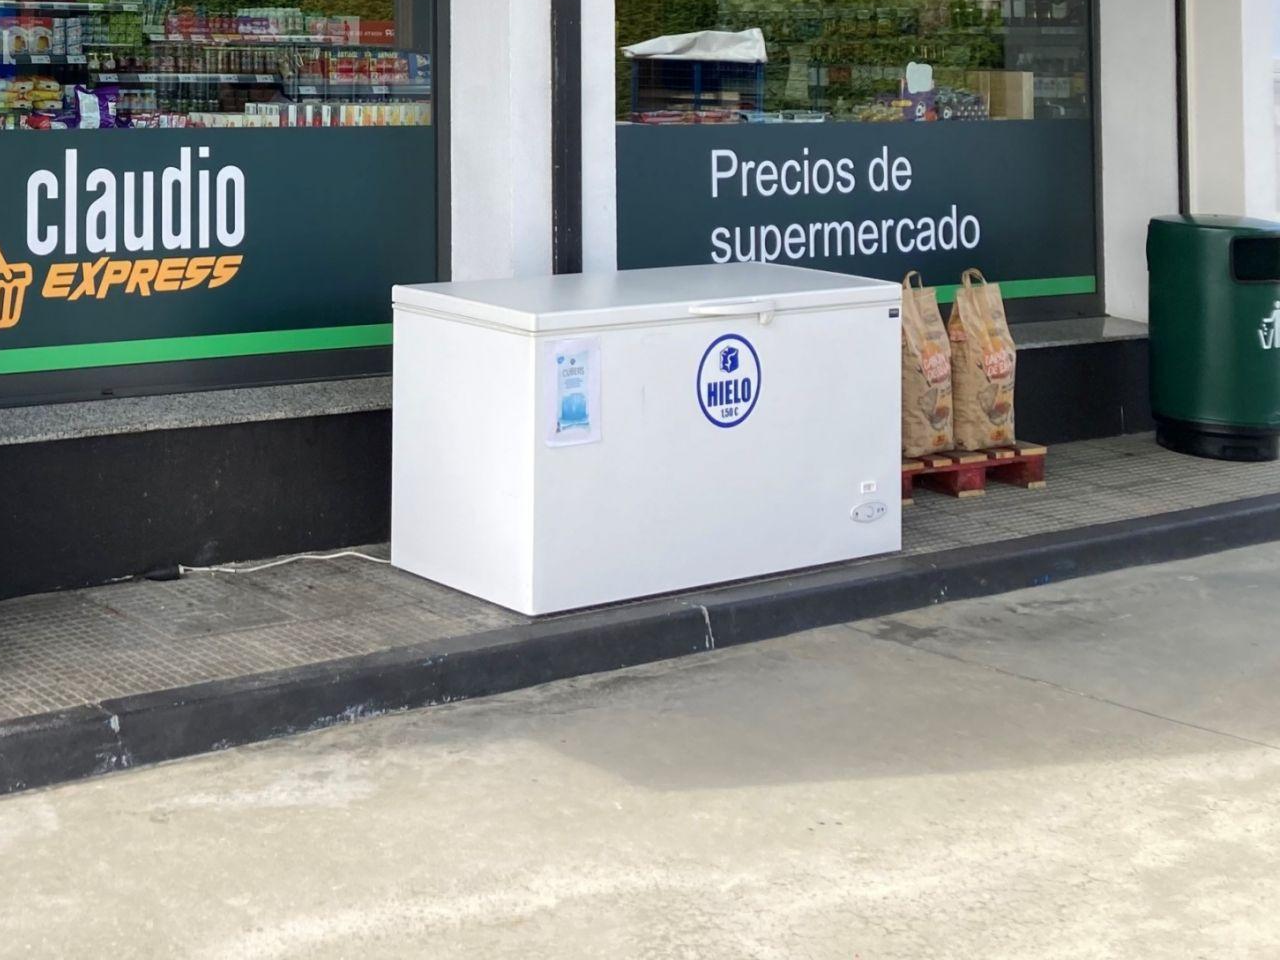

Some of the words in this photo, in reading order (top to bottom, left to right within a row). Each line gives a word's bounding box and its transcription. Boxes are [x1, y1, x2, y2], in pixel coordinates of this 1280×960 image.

[711, 147, 856, 198] Precios
[868, 145, 913, 192] de
[26, 146, 246, 256] claudio
[710, 204, 981, 264] supermercado
[41, 255, 244, 301] EXPRESS
[707, 377, 752, 408] HIELO
